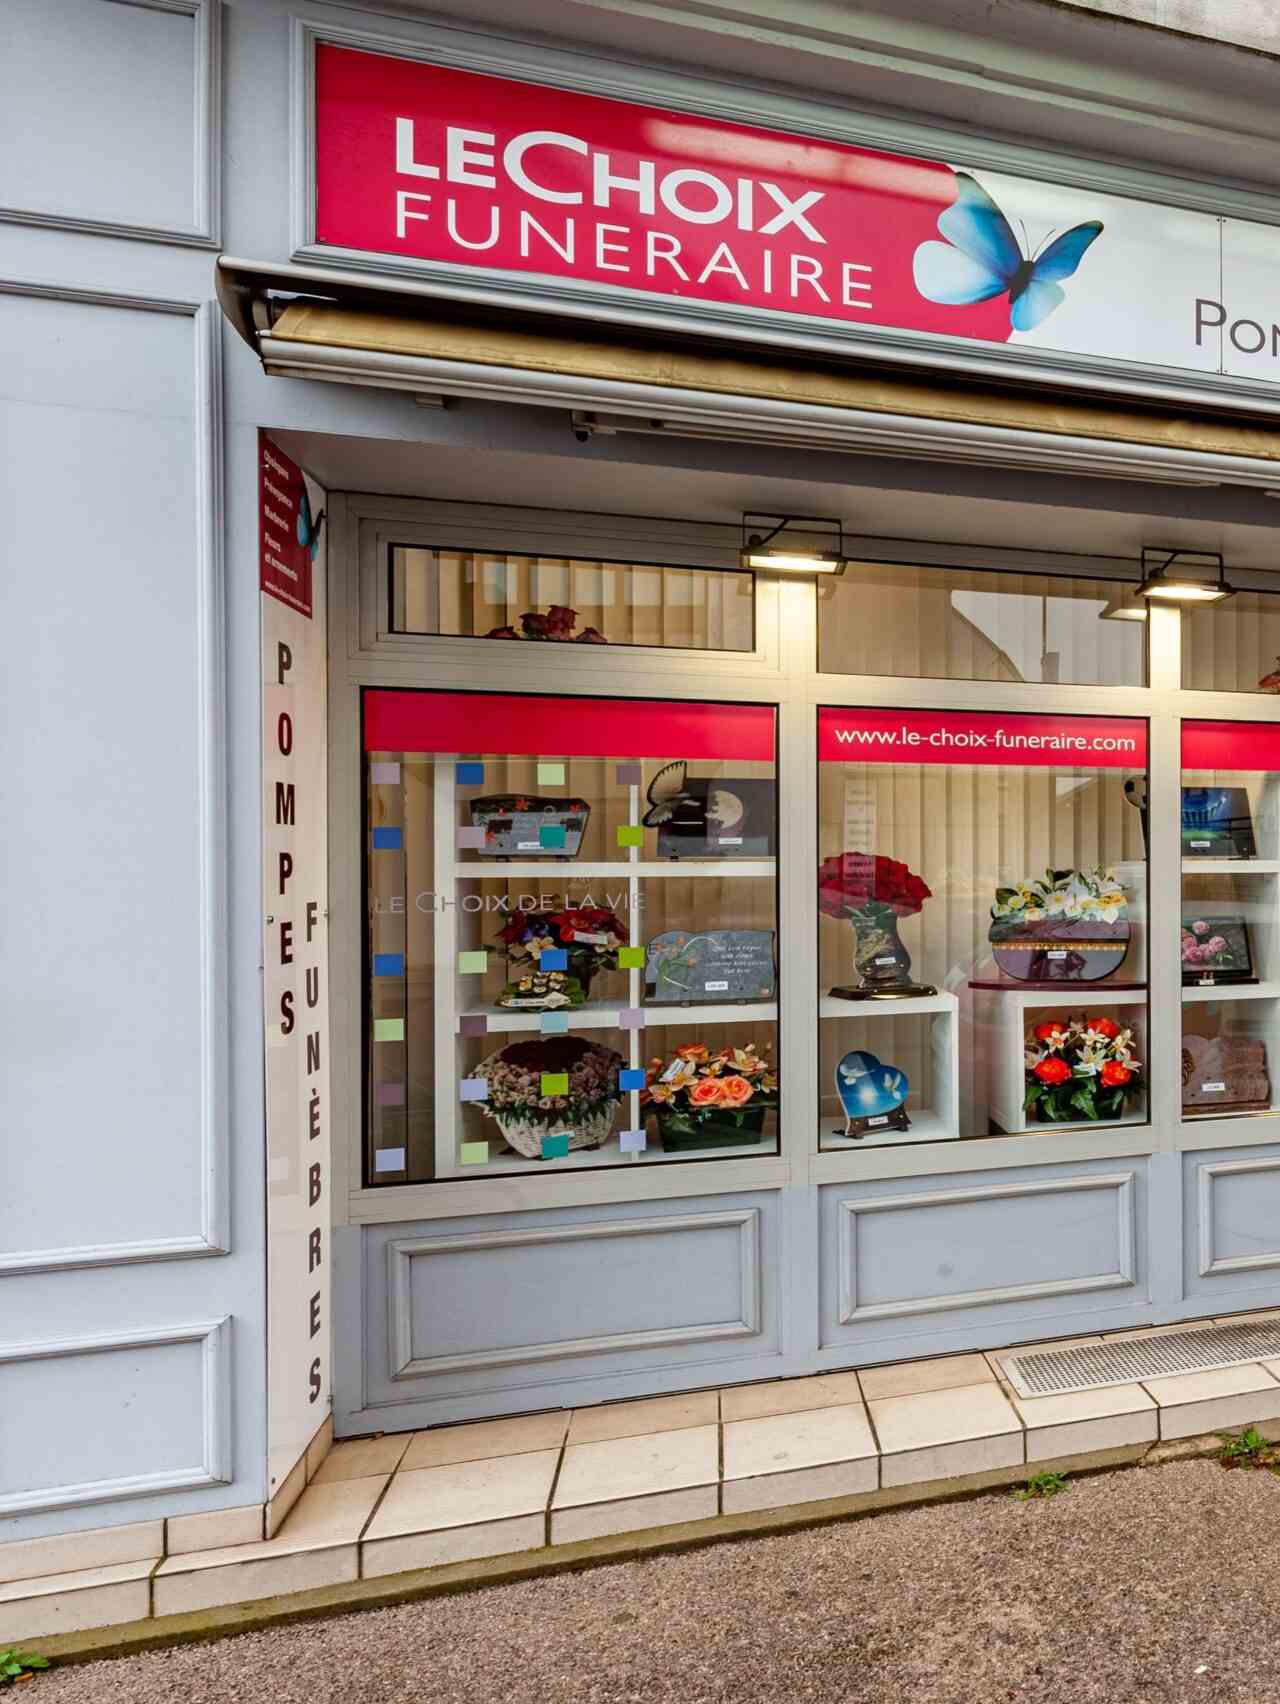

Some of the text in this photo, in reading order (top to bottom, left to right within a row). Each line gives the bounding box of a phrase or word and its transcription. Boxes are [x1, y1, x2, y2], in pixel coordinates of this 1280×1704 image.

[396, 190, 874, 309] FUNERAIRE
[835, 726, 1136, 751] www.le-choix-funeraire.com
[275, 641, 295, 1034] POMPES
[415, 892, 510, 912] CHOIX
[518, 895, 553, 912] DE
[564, 894, 598, 910] LA
[306, 902, 320, 1403] FUNÈBRES
